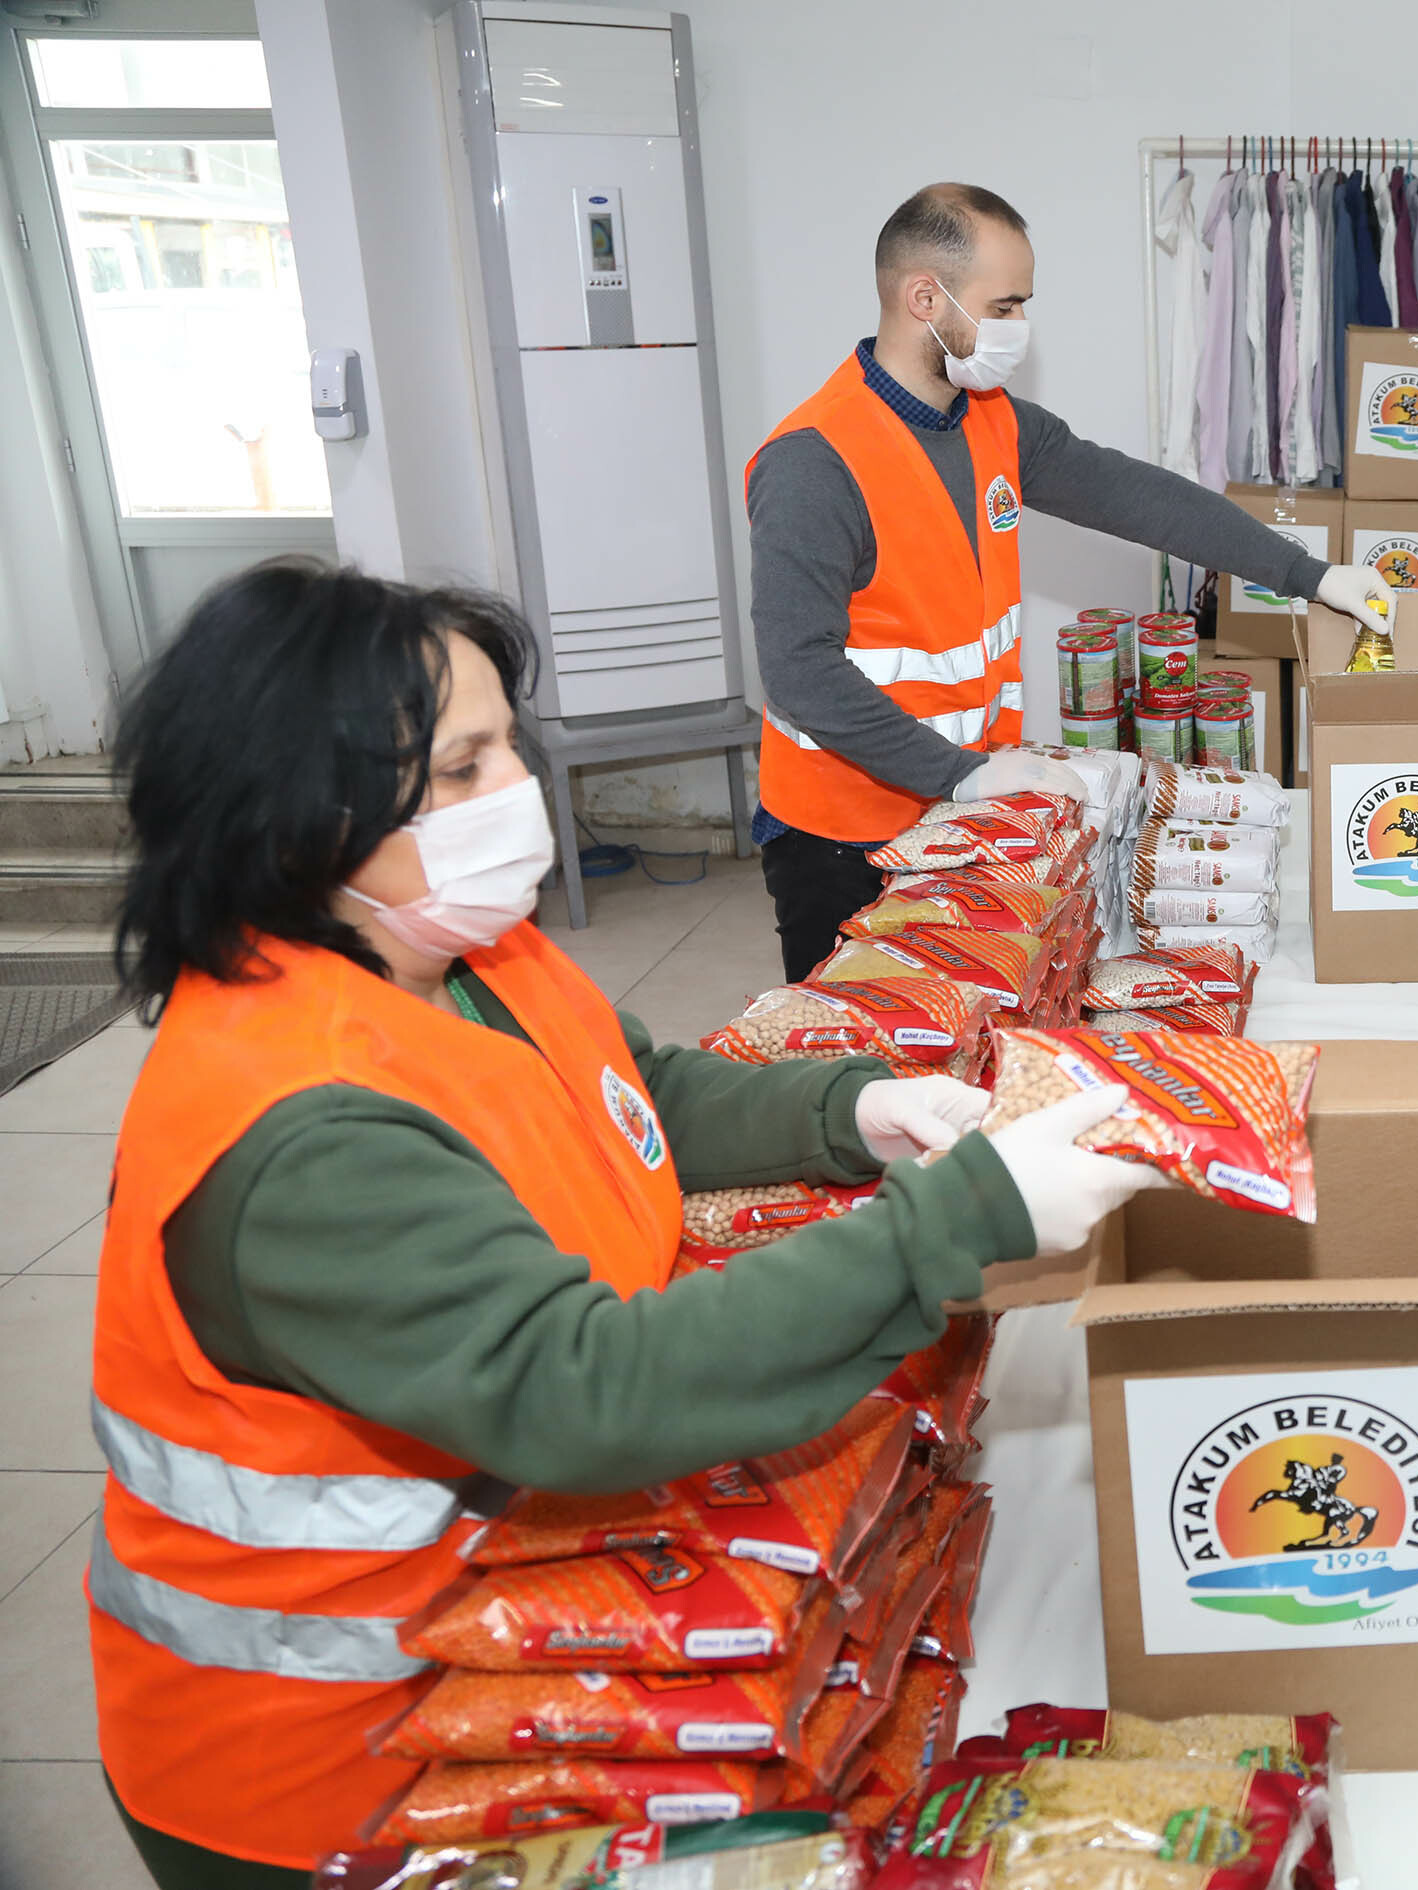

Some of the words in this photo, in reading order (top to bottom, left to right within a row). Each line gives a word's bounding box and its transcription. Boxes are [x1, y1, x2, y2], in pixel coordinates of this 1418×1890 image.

[1371, 379, 1398, 424] ATAKUM
[1352, 787, 1390, 862] ATAKUM
[1100, 1033, 1219, 1120] eyhanlar
[1184, 1420, 1261, 1563] ATAKUM
[1324, 1550, 1389, 1571] 1994
[1352, 1617, 1401, 1633] Afiyet
